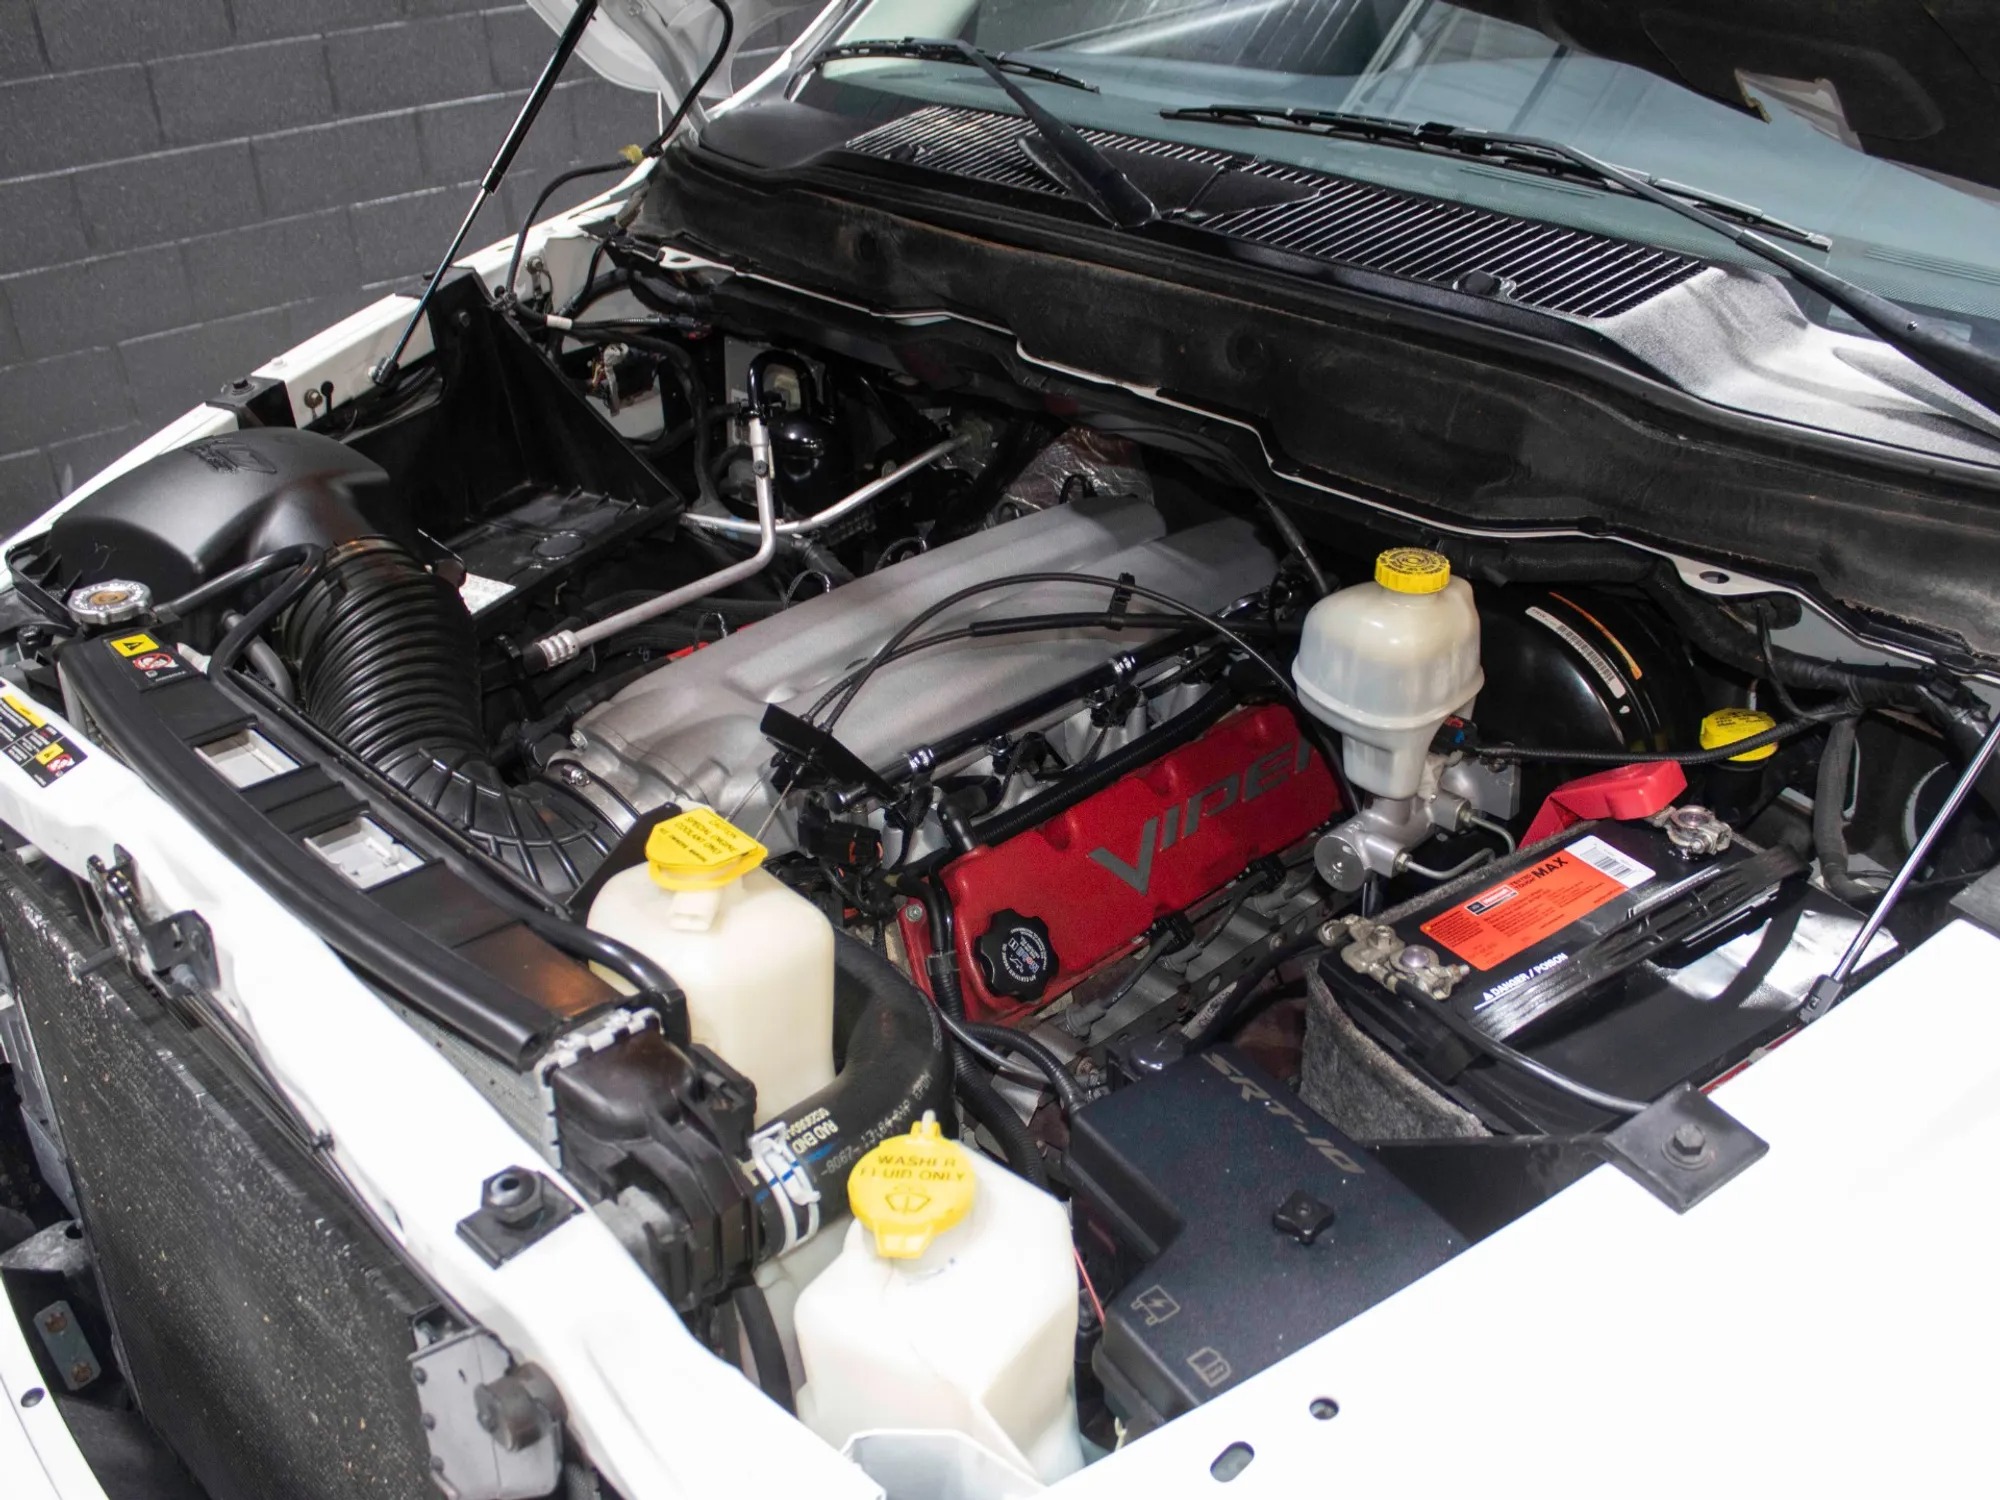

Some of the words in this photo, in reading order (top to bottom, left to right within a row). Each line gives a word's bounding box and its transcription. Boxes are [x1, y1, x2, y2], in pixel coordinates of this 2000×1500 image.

[1531, 857, 1568, 879] MAX
[1489, 972, 1531, 998] DANGER
[1533, 952, 1569, 974] POISON
[1200, 1052, 1366, 1174] SRT-10
[878, 1154, 957, 1168] WASHER
[860, 1166, 913, 1179] FLUID
[918, 1169, 966, 1182] ONLY
